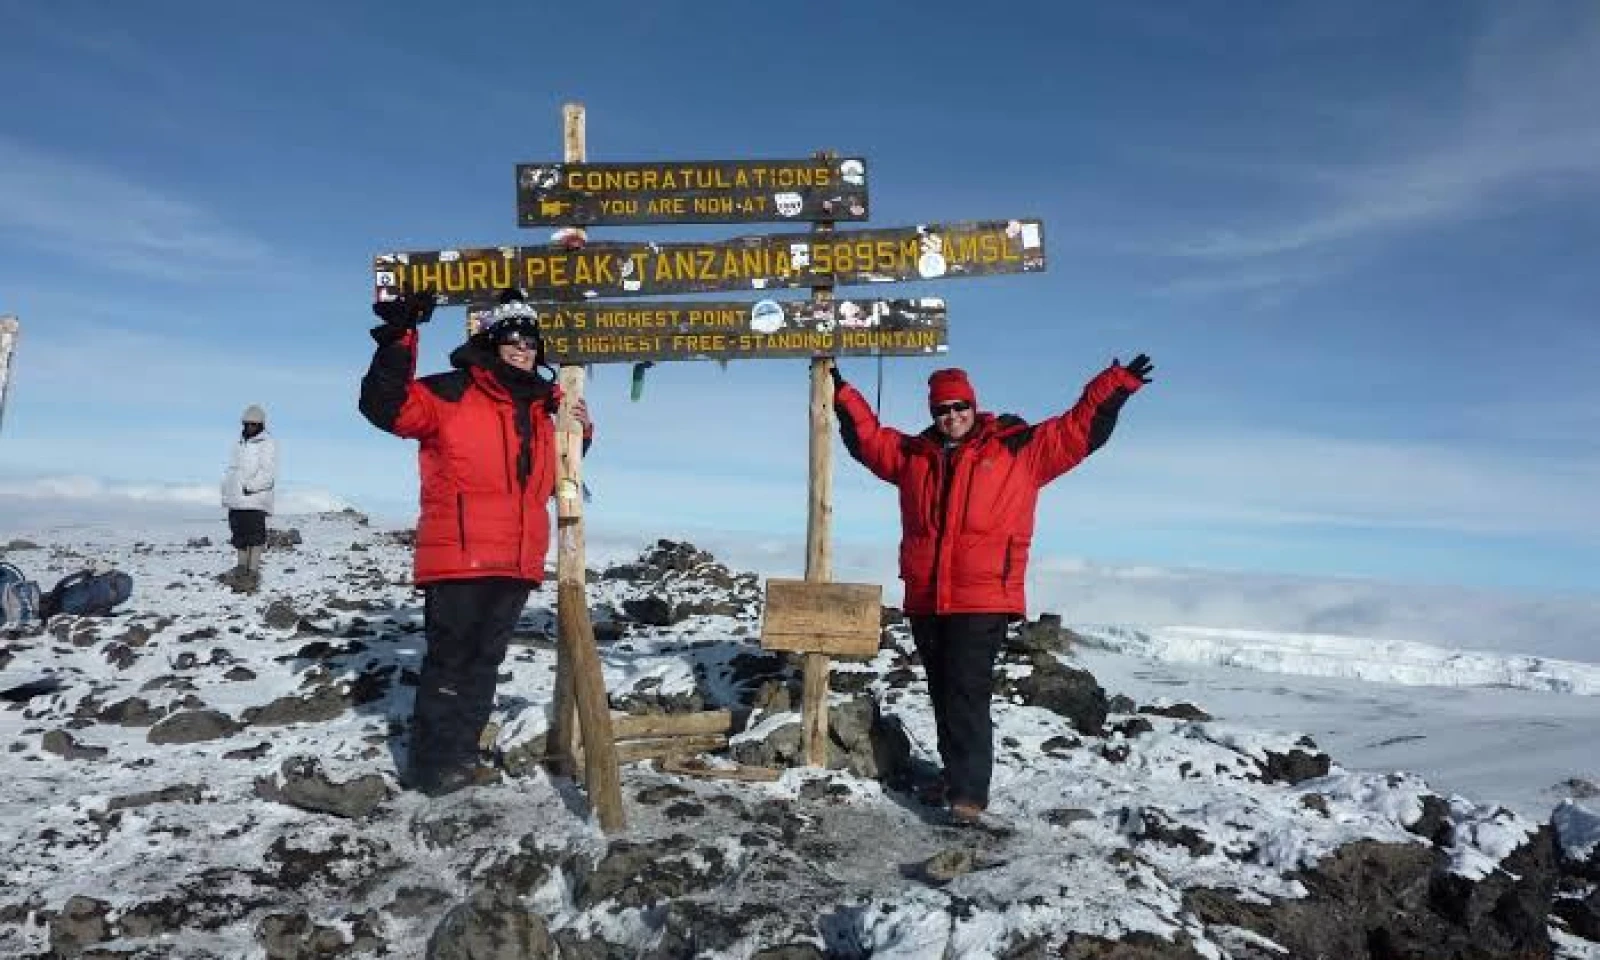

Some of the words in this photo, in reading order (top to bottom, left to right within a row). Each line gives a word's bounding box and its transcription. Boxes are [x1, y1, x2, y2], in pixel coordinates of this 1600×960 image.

[567, 167, 832, 191] CONGRATULATIONS
[601, 199, 639, 214] YOU
[648, 198, 687, 214] ARE
[694, 196, 733, 215] NOW
[741, 195, 767, 212] AT
[396, 257, 512, 293] UHURU
[595, 311, 680, 328] HIGHEST
[689, 310, 746, 327] POINT
[841, 331, 935, 349] MOUNTAIN
